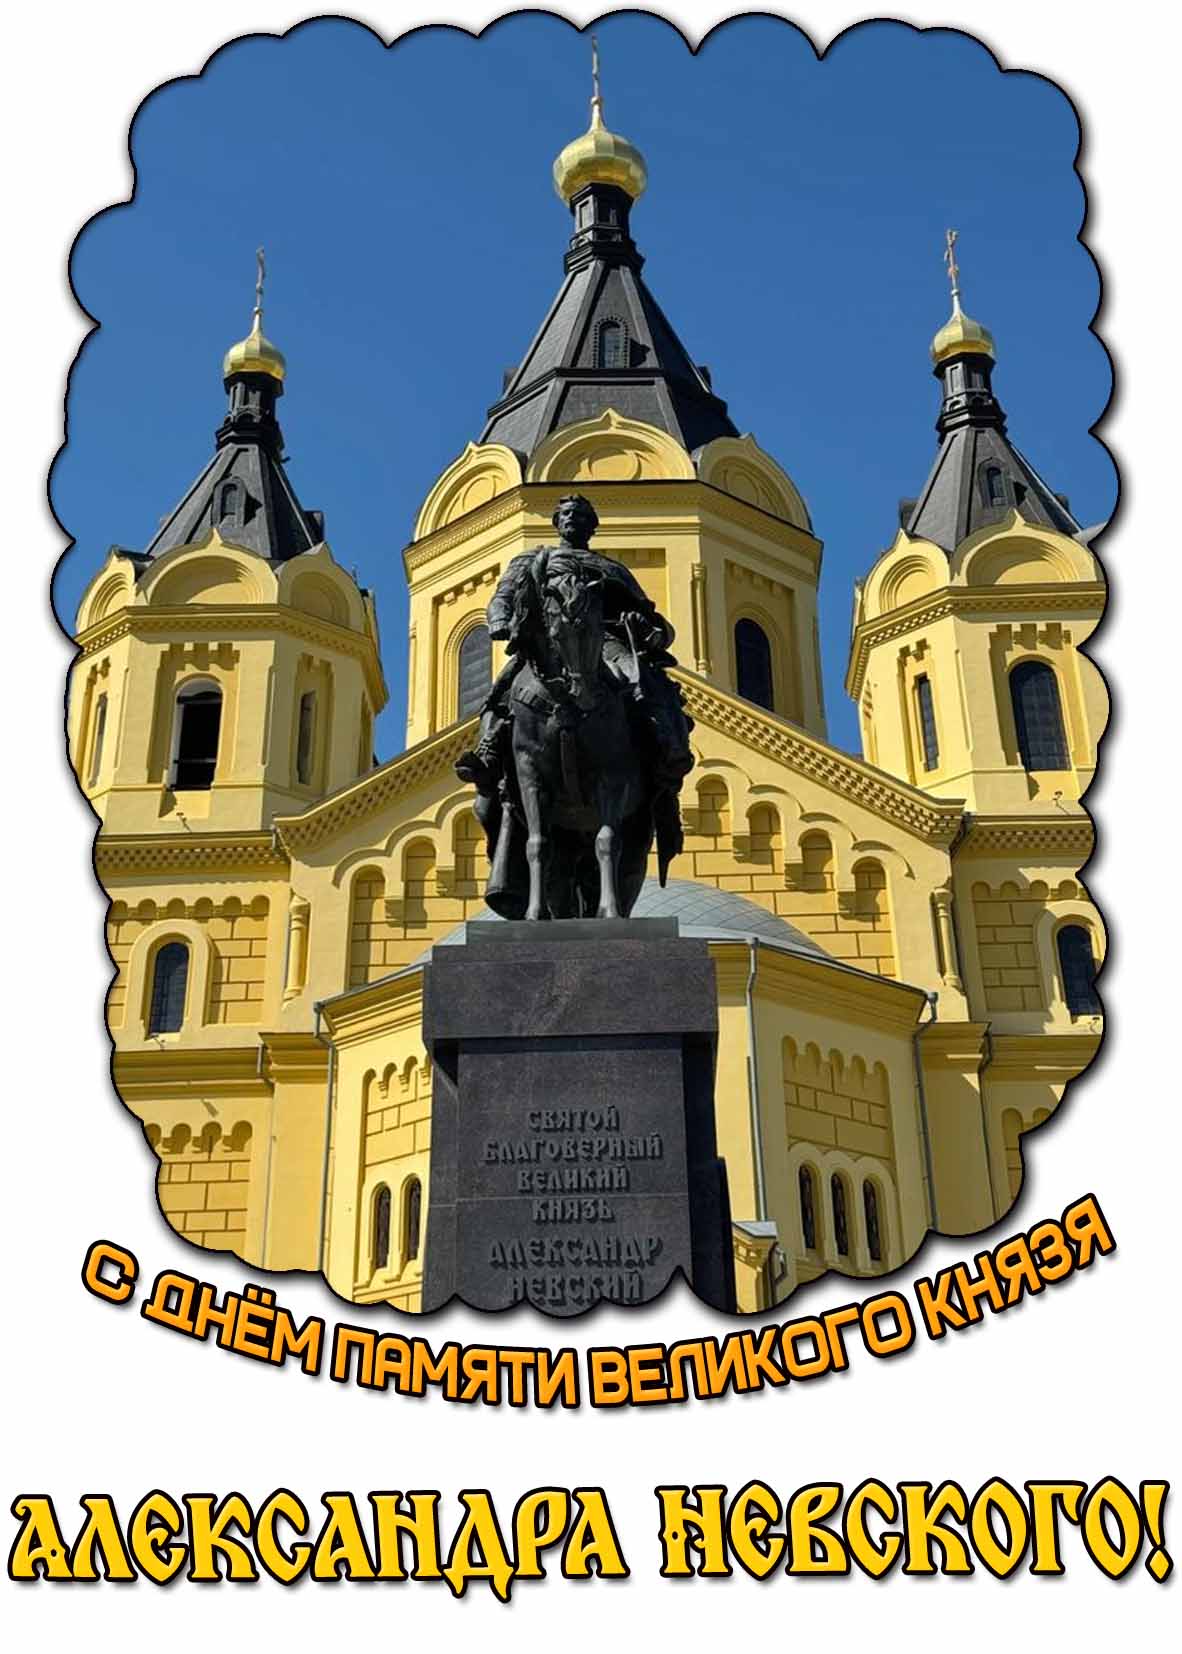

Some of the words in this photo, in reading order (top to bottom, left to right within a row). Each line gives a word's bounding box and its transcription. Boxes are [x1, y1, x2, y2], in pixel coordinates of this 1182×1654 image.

[528, 1106, 620, 1133] СВЯТОЙ
[481, 1134, 664, 1165] БЛАГОВЕРНЫЙ
[517, 1164, 630, 1193] ВЕЛИКИЙ
[531, 1199, 615, 1224] КНЯЗЬ
[488, 1235, 664, 1268] АЛЕКСАНДР
[508, 1271, 643, 1305] НЕВСКИЙ
